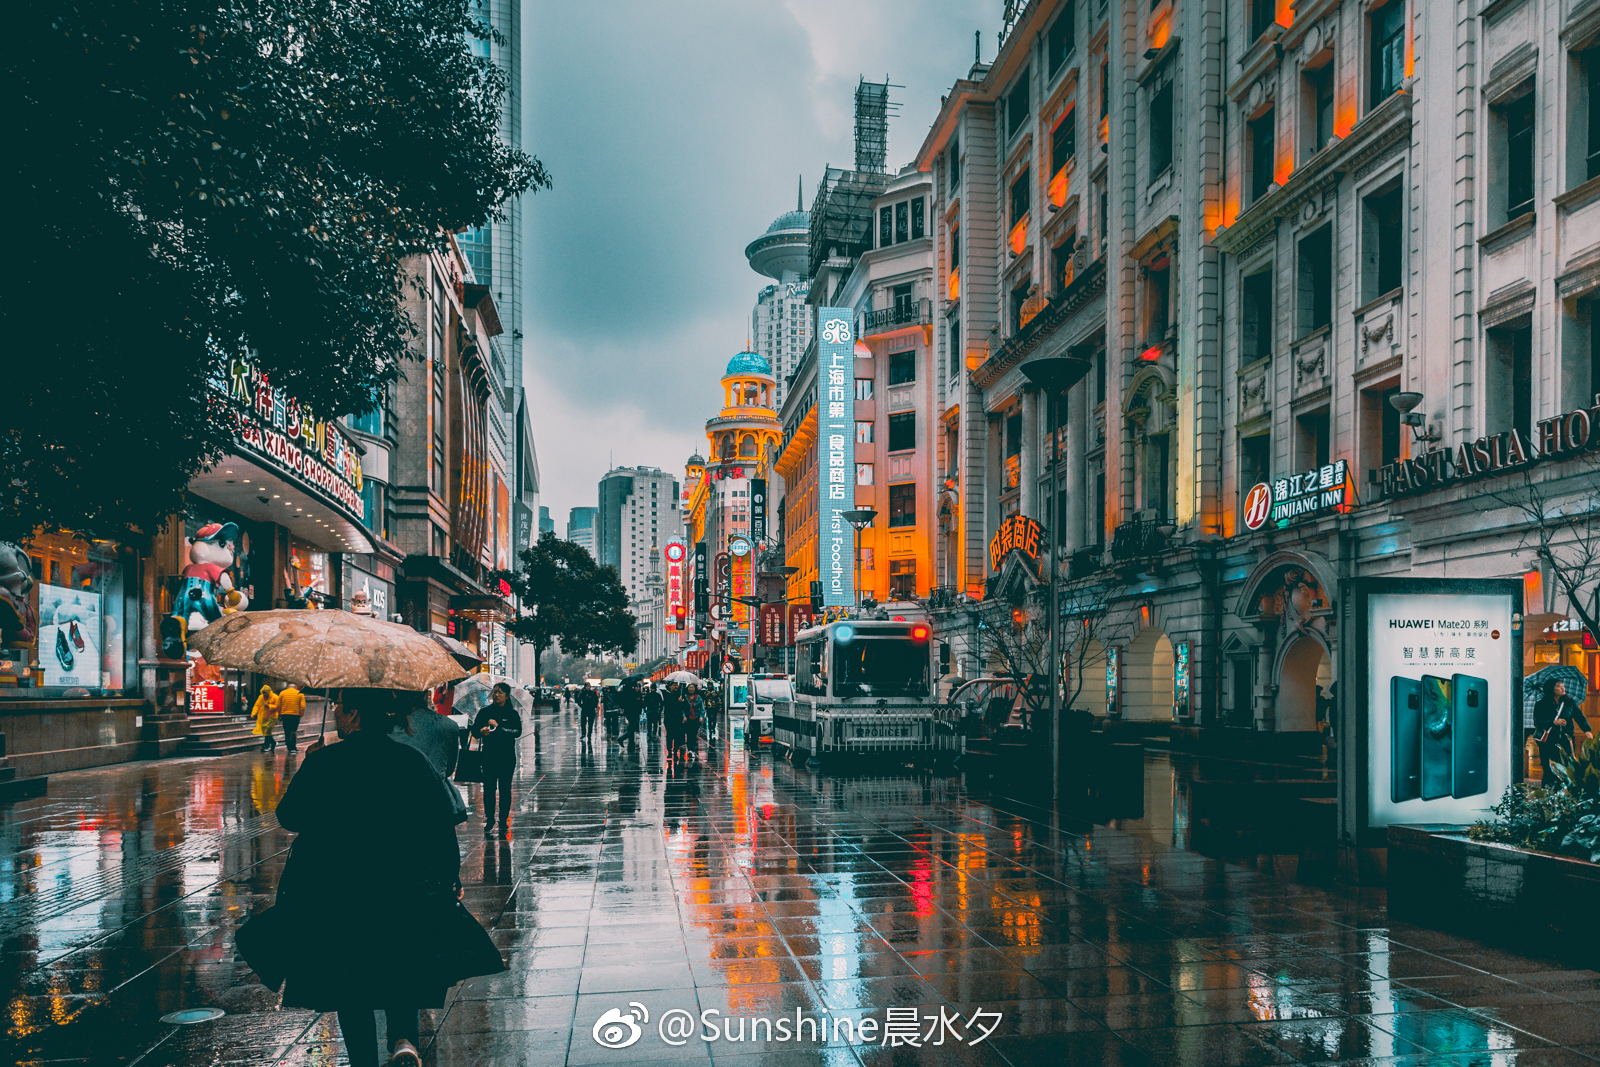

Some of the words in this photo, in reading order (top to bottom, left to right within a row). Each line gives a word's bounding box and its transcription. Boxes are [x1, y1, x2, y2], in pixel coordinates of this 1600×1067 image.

[828, 352, 845, 499] 上海市第一食品商店
[264, 430, 302, 473] XIANG
[303, 454, 345, 498] SHOPPING
[1380, 447, 1447, 496] EAST
[1454, 427, 1528, 479] ASIA
[1275, 464, 1334, 502] 锦江之星
[1334, 460, 1344, 485] 酒店
[831, 509, 843, 534] First
[1274, 496, 1318, 521] JINJIANG
[1320, 489, 1341, 508] INN
[989, 515, 1040, 571] 时装商店
[831, 538, 843, 595] Foodhall
[1389, 619, 1434, 629] HUAWEI
[1438, 619, 1471, 629] Mate20
[1473, 619, 1489, 630] 系列
[1403, 646, 1476, 659] 智慧新高度
[189, 702, 214, 710] SALE
[864, 728, 900, 737] POLICE
